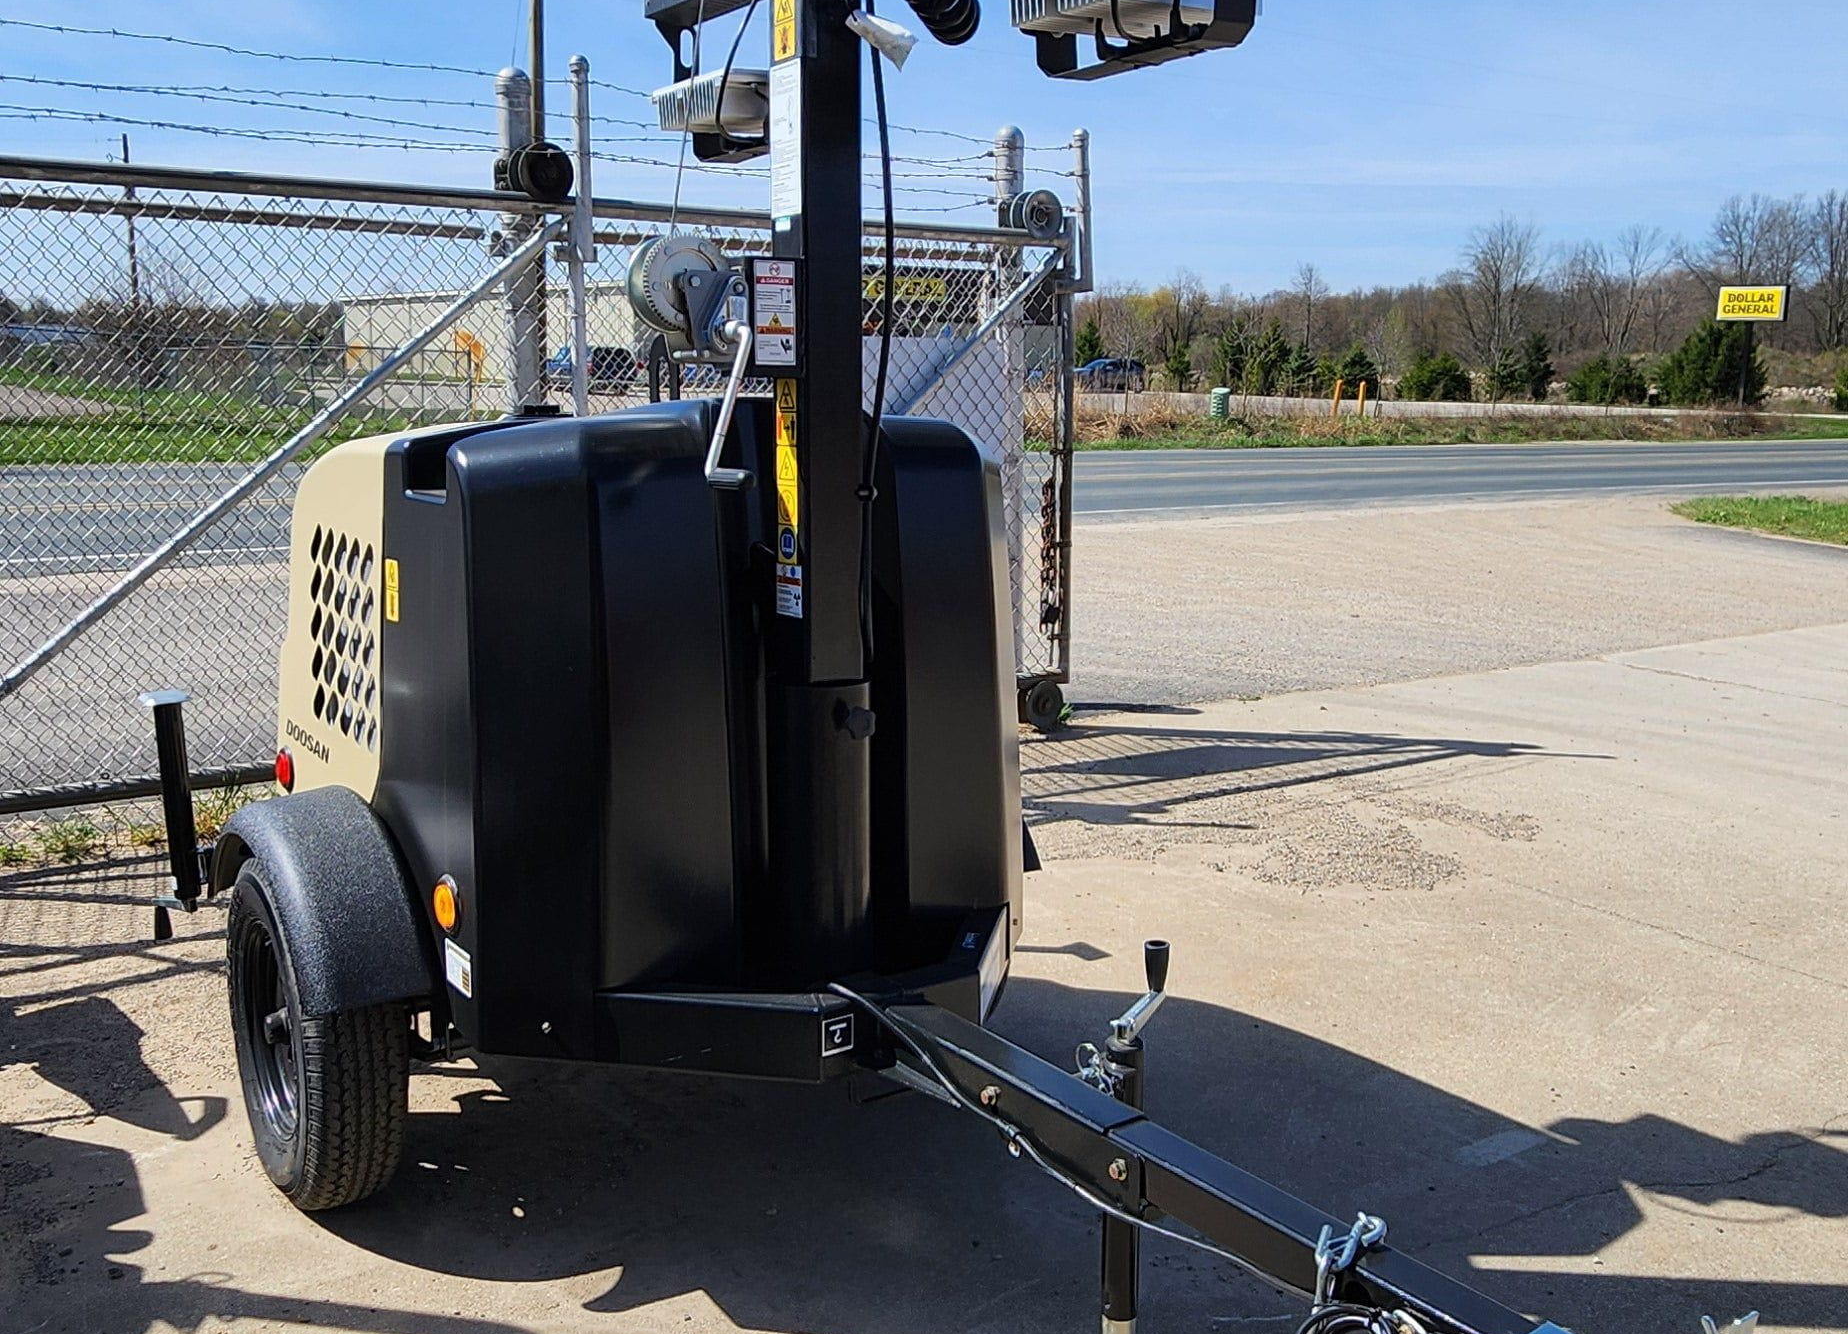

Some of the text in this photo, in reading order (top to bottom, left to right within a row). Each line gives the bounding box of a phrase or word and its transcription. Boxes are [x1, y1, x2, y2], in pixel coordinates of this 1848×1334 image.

[1727, 292, 1775, 303] DOLLAR
[1722, 304, 1777, 314] GENERAL
[286, 718, 330, 764] DOOSAN
